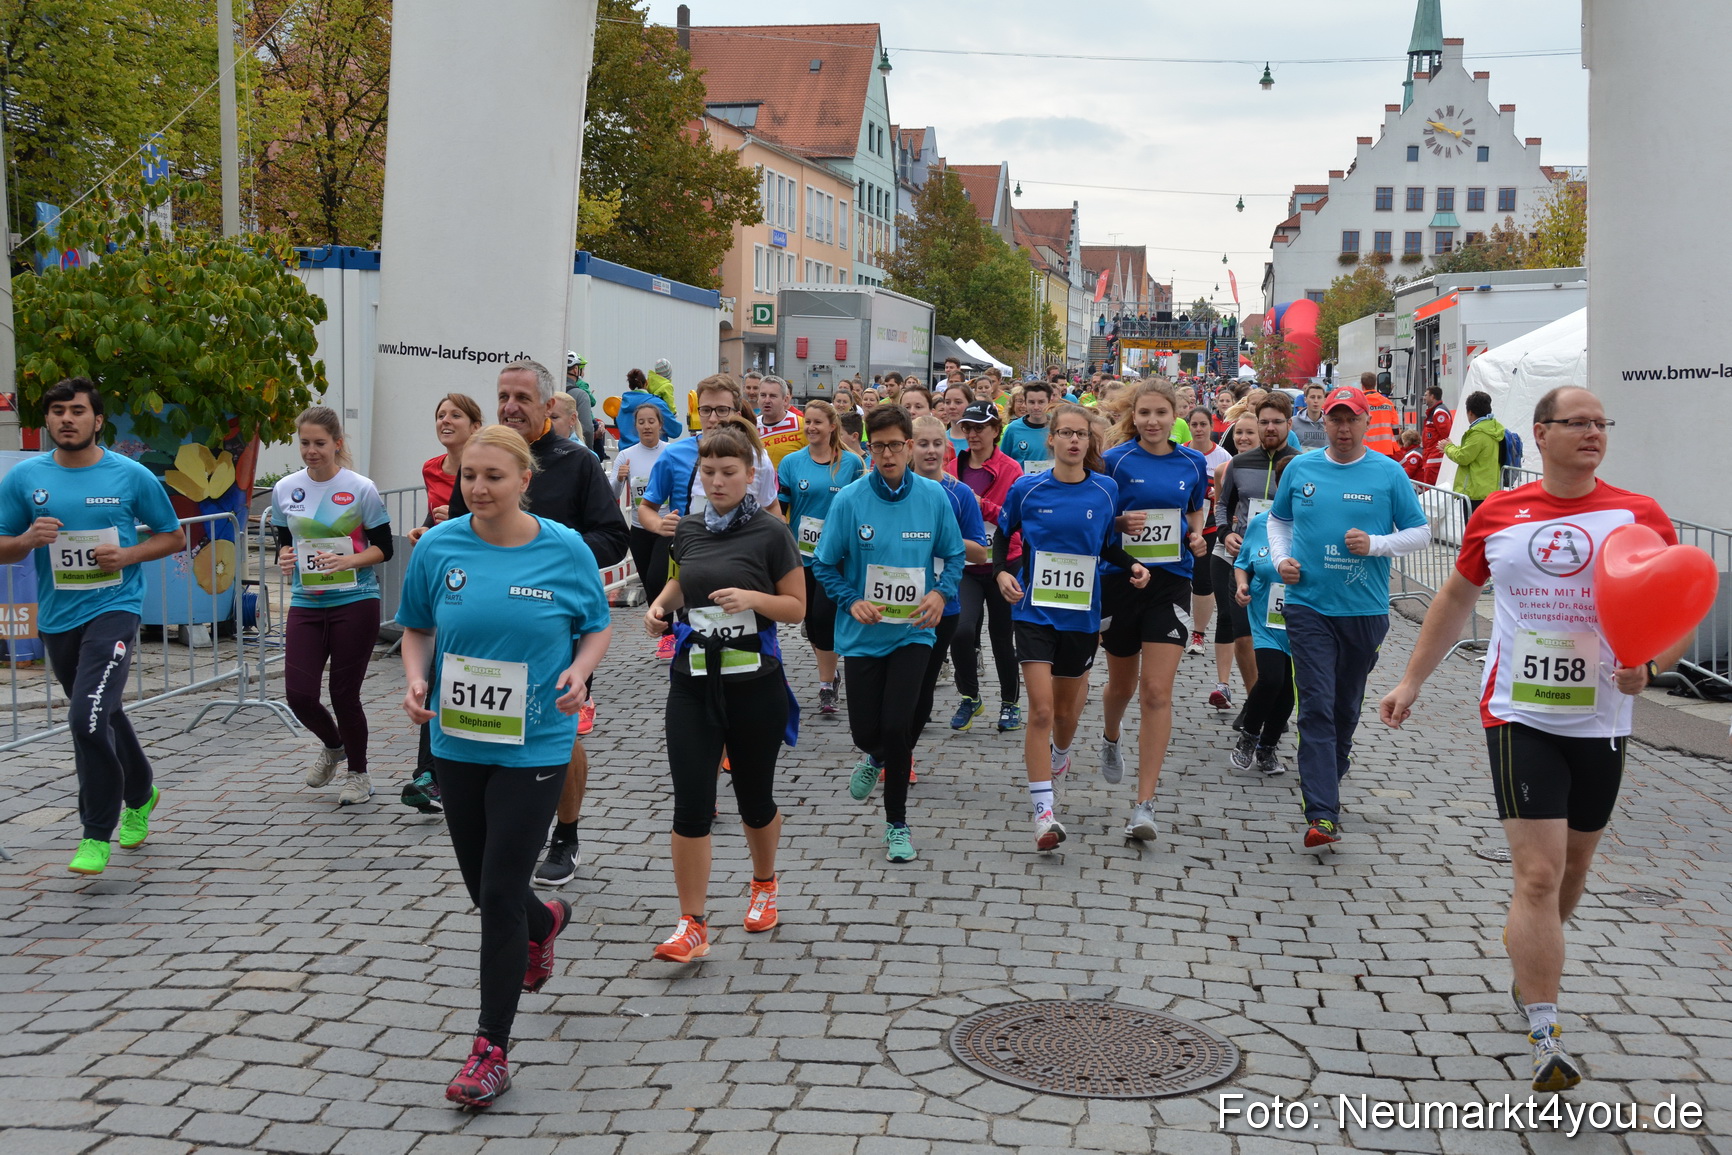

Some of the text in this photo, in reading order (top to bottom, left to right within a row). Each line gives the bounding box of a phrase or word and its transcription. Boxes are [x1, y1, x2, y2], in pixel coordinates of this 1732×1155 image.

[756, 306, 771, 322] D
[773, 434, 801, 445] BÖGL
[1179, 480, 1186, 491] 2
[1343, 493, 1373, 501] BOCK
[1086, 509, 1093, 520] 6
[1324, 544, 1340, 556] 18.
[1324, 556, 1360, 564] Neumarkter
[1323, 563, 1353, 571] Stadtlauf
[1041, 569, 1084, 588] 5116
[509, 587, 553, 600] BOCK
[873, 582, 917, 602] 5109
[1509, 585, 1549, 597] LAUFEN
[1554, 588, 1576, 597] MIT
[885, 606, 902, 615] Klara
[1519, 601, 1530, 609] Dr.
[1559, 602, 1571, 610] Dr.
[1520, 612, 1599, 624] Leistungsdiagnostik
[471, 665, 501, 675] BOCK
[1523, 654, 1586, 682] 5158
[87, 640, 127, 734] Champion
[452, 681, 513, 711] 5147
[1535, 688, 1571, 700] Andreas
[459, 714, 502, 729] Stephanie
